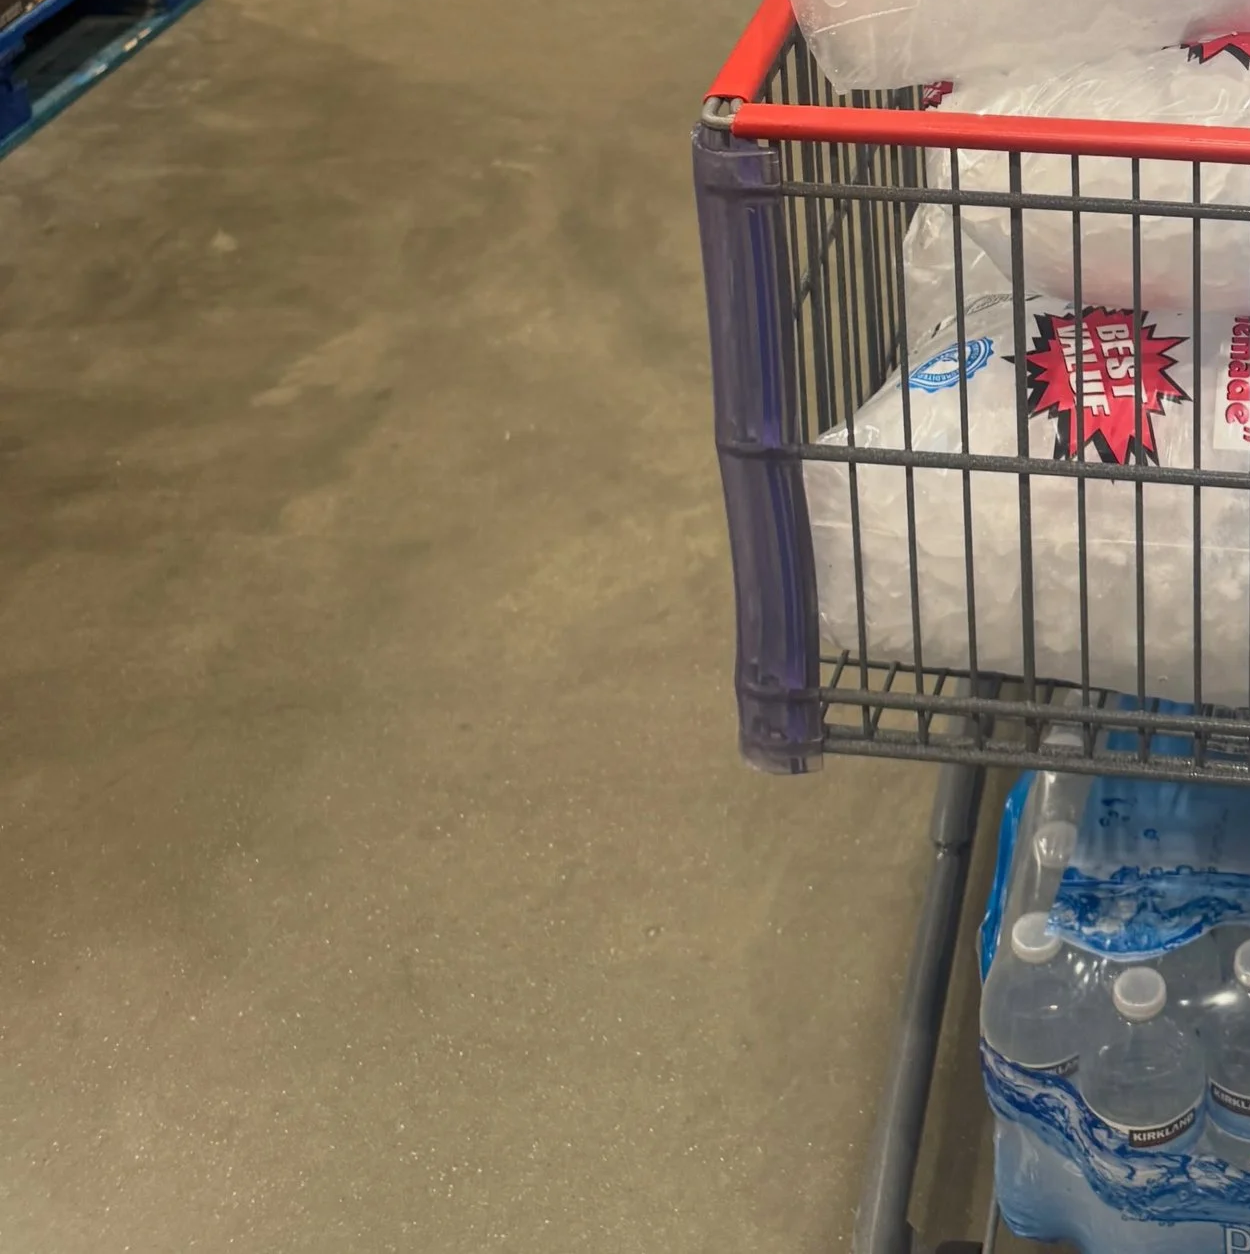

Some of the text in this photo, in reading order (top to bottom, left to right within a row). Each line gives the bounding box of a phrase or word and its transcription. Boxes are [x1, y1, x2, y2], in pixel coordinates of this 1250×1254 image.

[1057, 322, 1111, 418] VALUE
[1096, 322, 1149, 405] BEST
[1132, 1112, 1194, 1143] KIRKLAND
